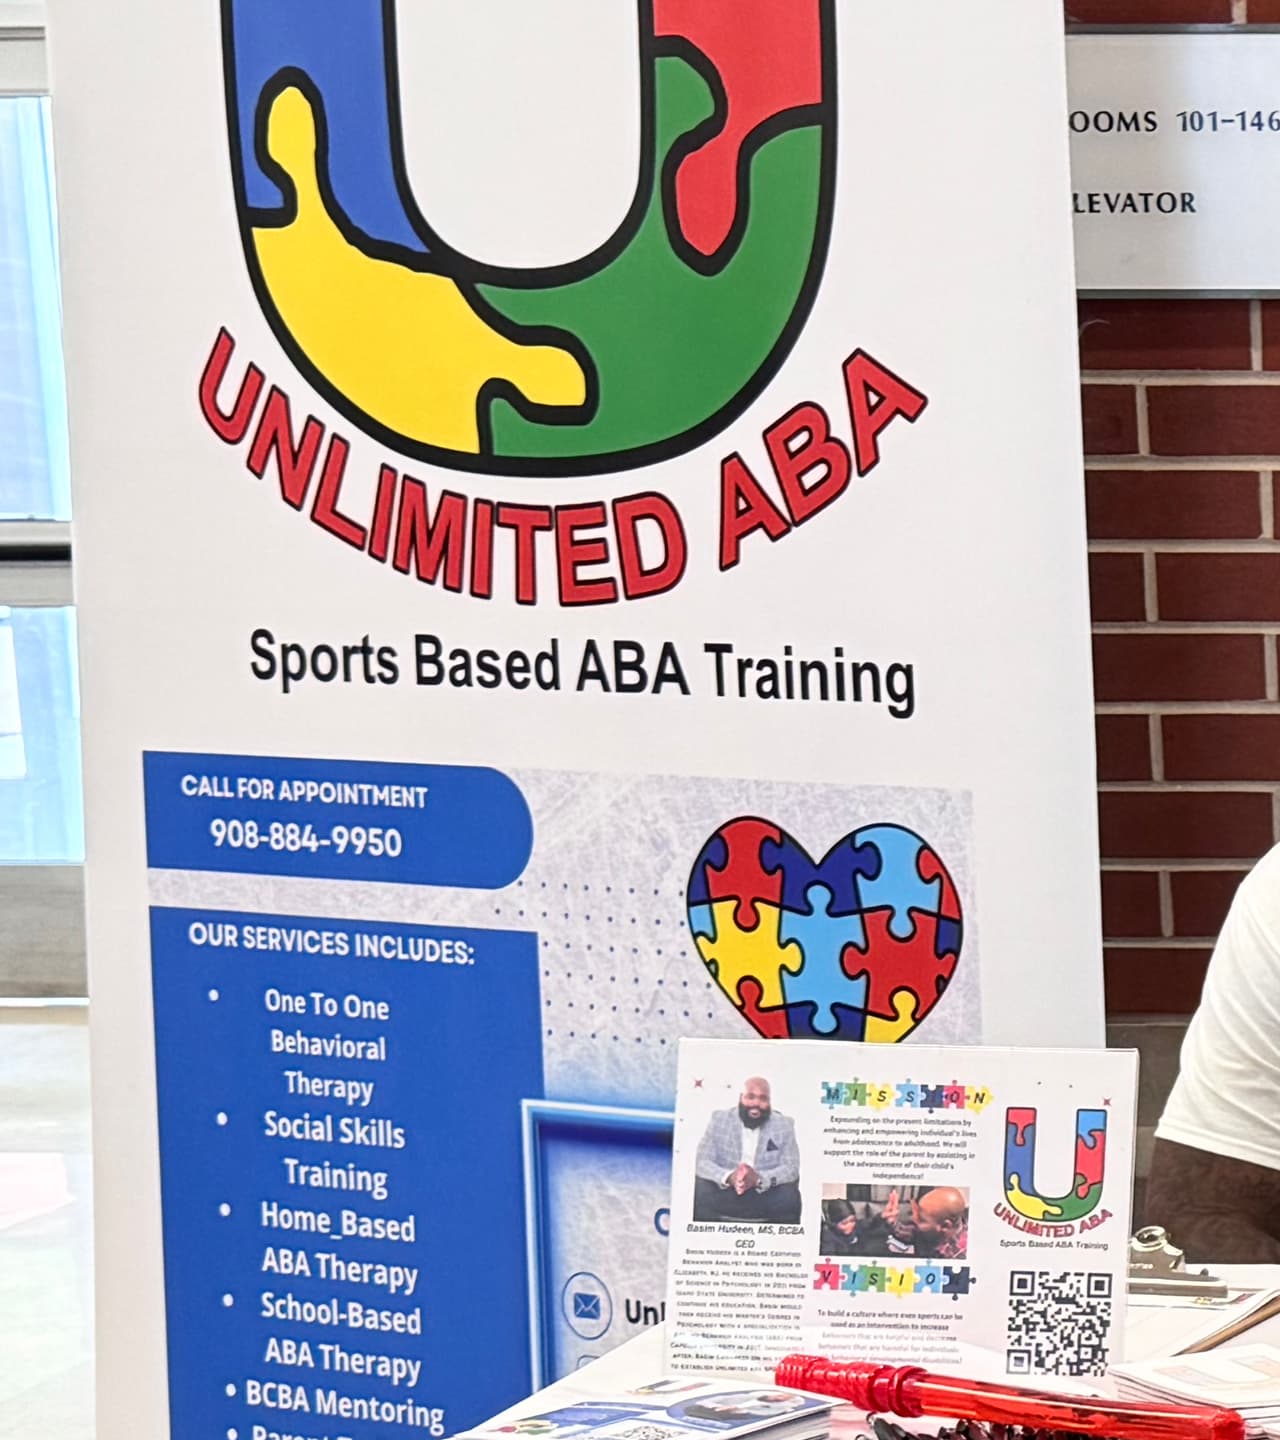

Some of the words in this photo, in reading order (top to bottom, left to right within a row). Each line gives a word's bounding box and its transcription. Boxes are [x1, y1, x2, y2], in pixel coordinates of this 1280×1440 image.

[1068, 110, 1158, 133] OOMS
[1072, 192, 1197, 213] LEVATOR
[198, 326, 688, 607] UNLIMITED
[717, 346, 928, 571] ABA
[249, 629, 400, 694] Sports
[415, 636, 560, 692] Based
[574, 640, 691, 698] ABA
[704, 643, 916, 719] Training
[181, 775, 234, 798] CALL
[238, 778, 275, 801] FOR
[279, 780, 428, 809] APPOINTMENT
[210, 818, 402, 858] 908-884-9950
[188, 922, 238, 948] OUR
[242, 926, 349, 957] SERVICES
[355, 934, 475, 965] INCLUDES:
[264, 988, 306, 1013] One
[310, 992, 338, 1017] To
[343, 994, 390, 1020] One
[271, 1029, 386, 1061] Behavioral
[283, 1070, 374, 1107] Therapy
[827, 1088, 985, 1104] MISSON
[264, 1110, 333, 1142] Social
[339, 1117, 406, 1149] Skills
[283, 1158, 389, 1200] Training
[261, 1200, 415, 1243] Home_Based
[993, 1202, 1074, 1238] UNLIMITED
[1079, 1209, 1113, 1233] ABA
[261, 1247, 311, 1278] ABA
[315, 1252, 418, 1295] Therapy
[822, 1271, 960, 1287] VISIO
[260, 1291, 422, 1335] School-Based
[264, 1337, 314, 1368] ABA
[318, 1344, 421, 1387] Therapy
[246, 1379, 310, 1412] BCBA
[316, 1388, 444, 1437] Mentoring
